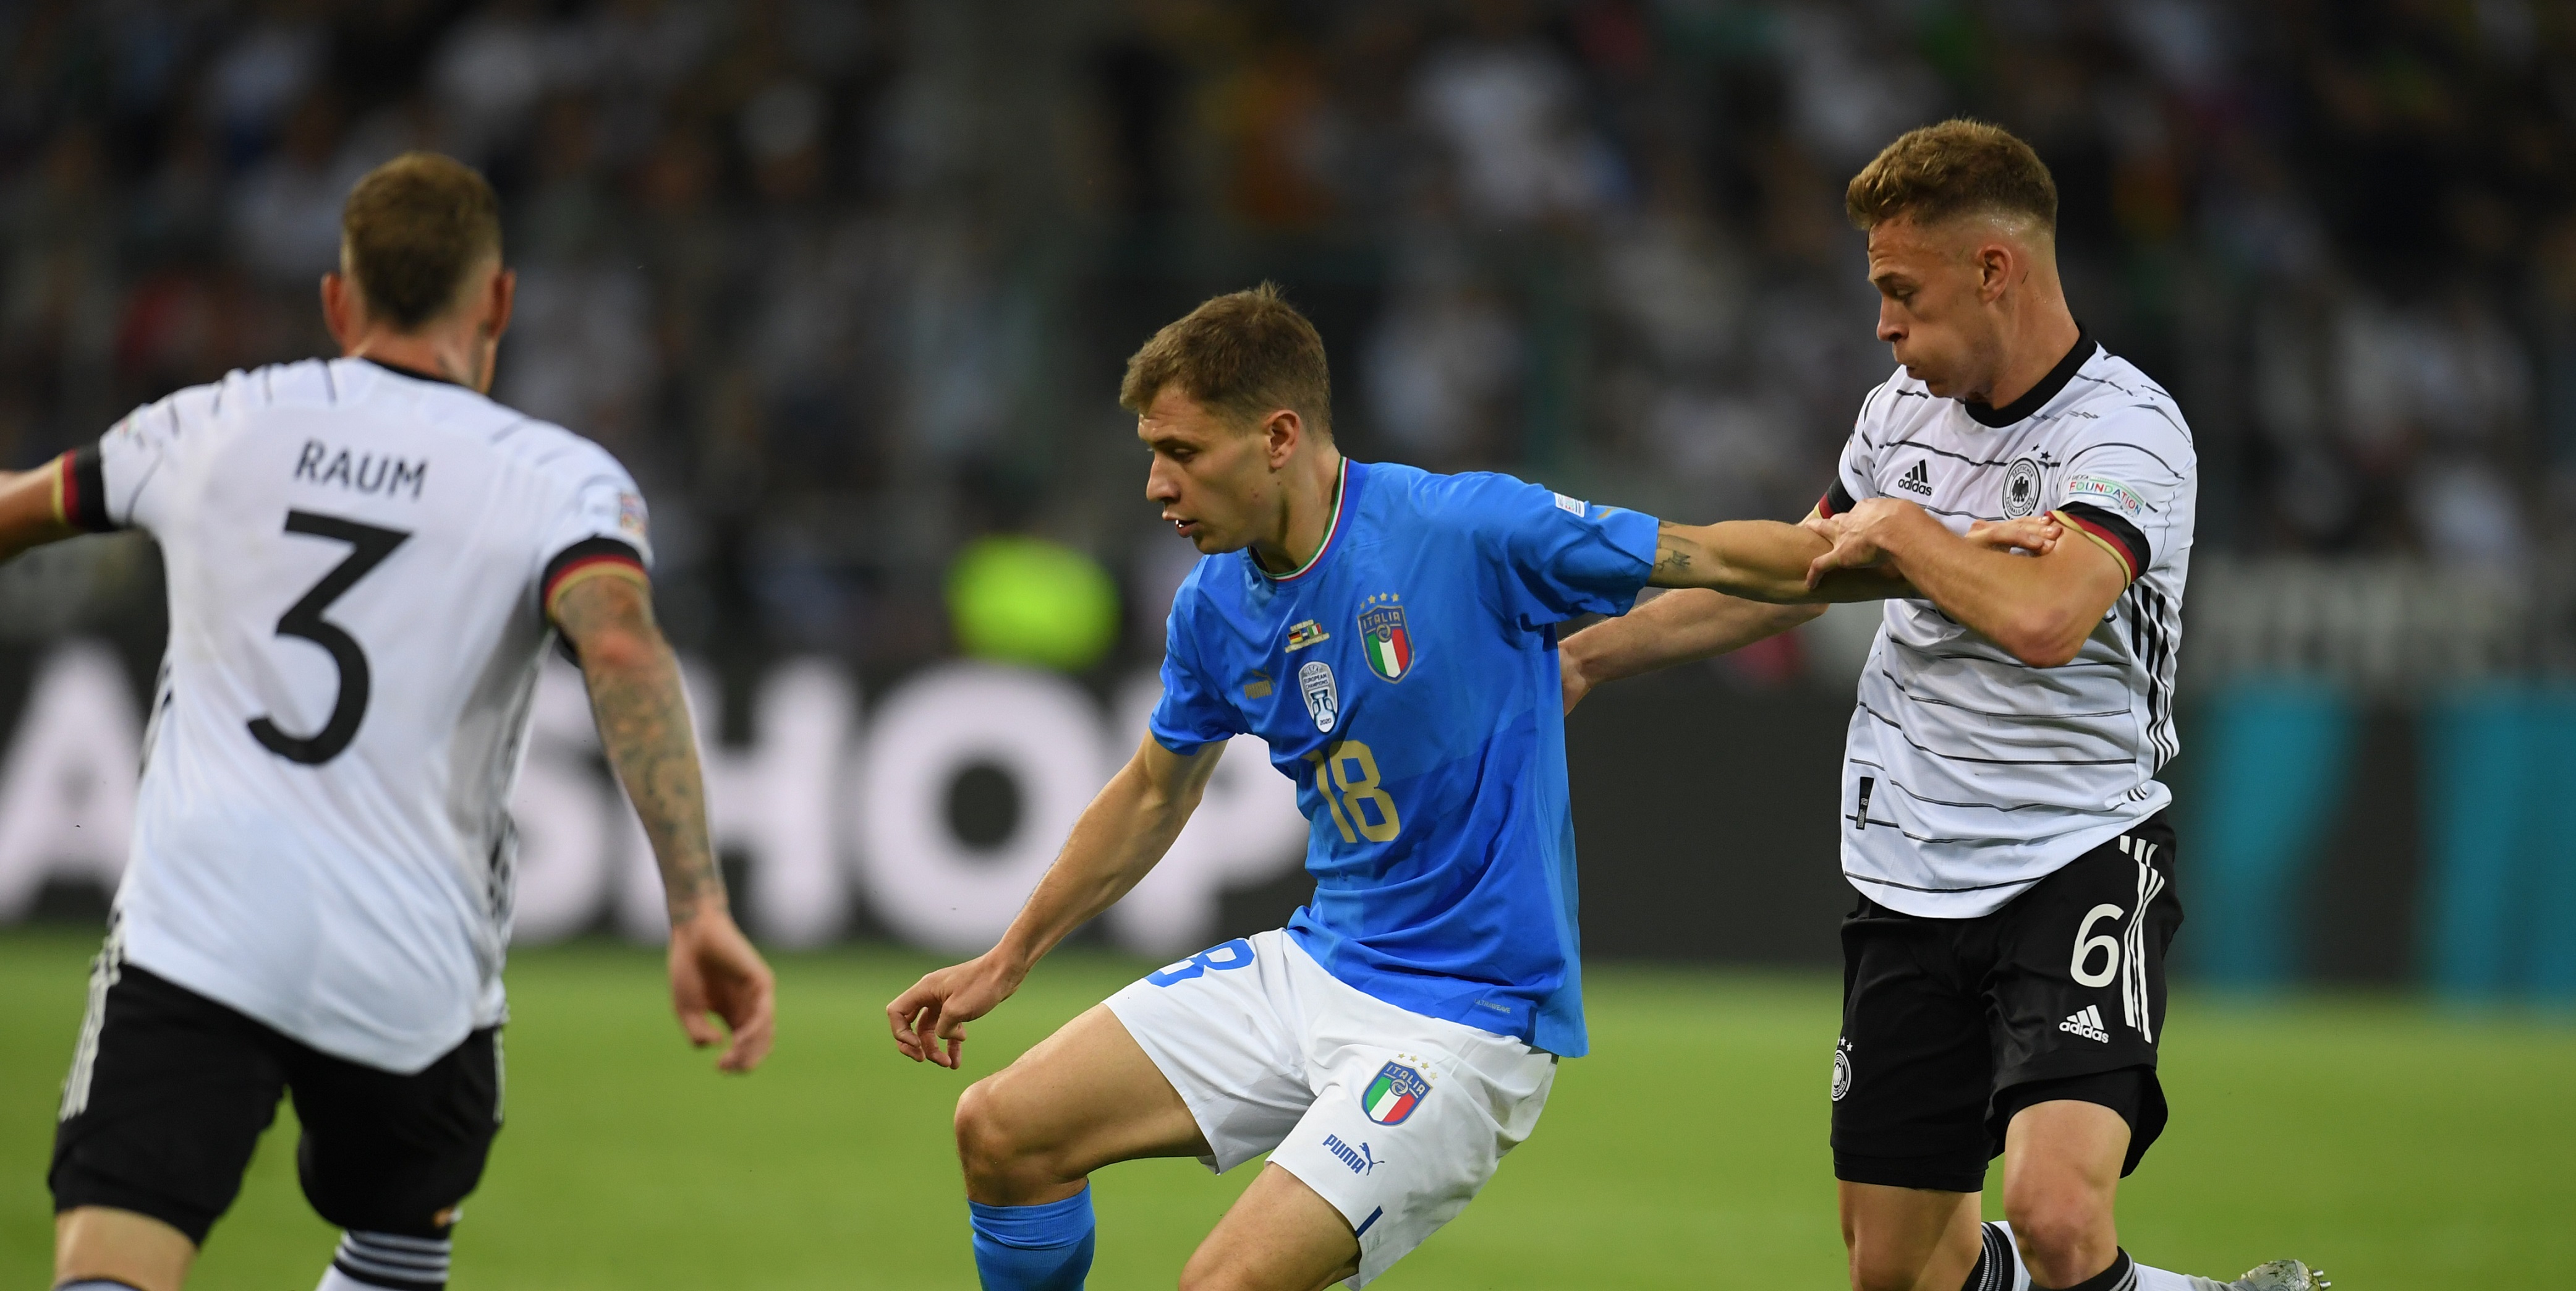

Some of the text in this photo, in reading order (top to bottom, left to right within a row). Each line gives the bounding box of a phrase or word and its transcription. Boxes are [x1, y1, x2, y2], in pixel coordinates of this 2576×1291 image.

[295, 438, 428, 500] RAUM
[1898, 478, 1932, 496] adidas
[2069, 482, 2142, 515] FOUNDATION
[1363, 611, 1401, 629] ITALIA
[247, 509, 415, 765] 3
[1304, 673, 1327, 683] EUROPEAN
[1301, 740, 1400, 843] 18
[2070, 903, 2124, 987] 6
[2059, 1021, 2109, 1044] adidas
[1386, 1065, 1426, 1095] ITALIA
[1322, 1134, 1366, 1174] PUMA
